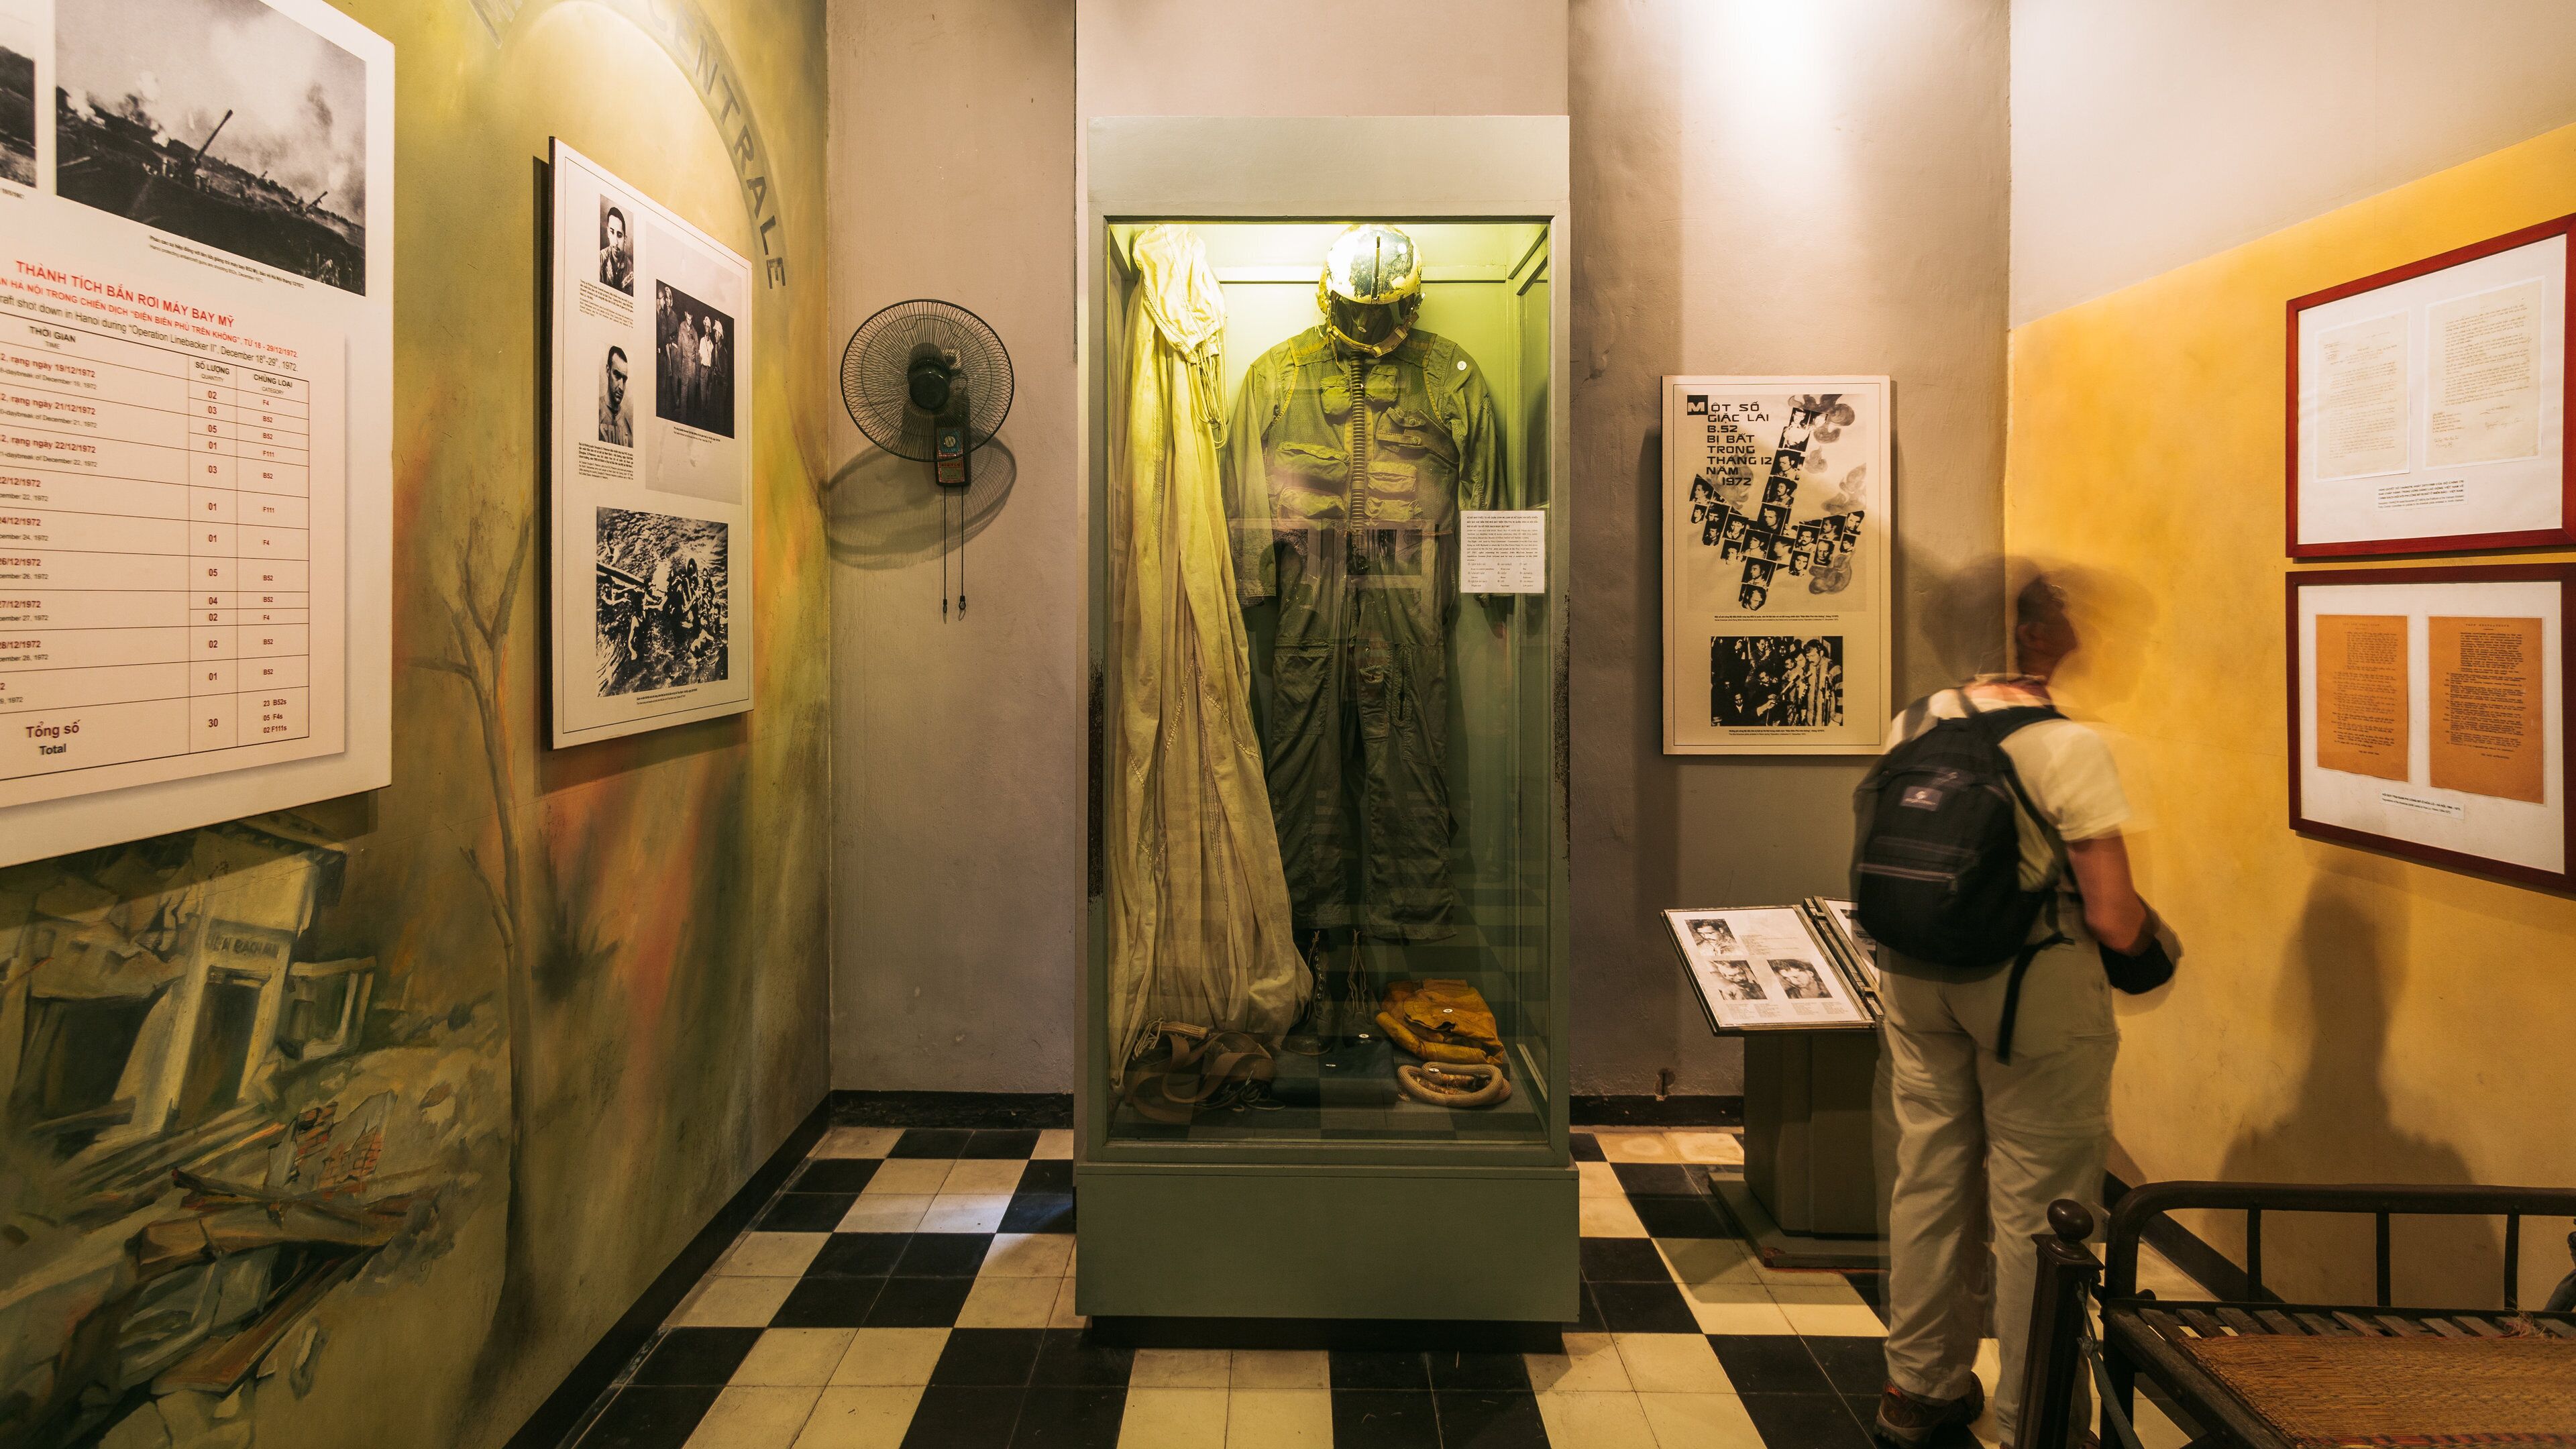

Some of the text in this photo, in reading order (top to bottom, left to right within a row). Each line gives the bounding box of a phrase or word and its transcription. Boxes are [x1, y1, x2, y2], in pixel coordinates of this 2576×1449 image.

[16, 260, 66, 284] THÀNH
[71, 276, 102, 294] TÍCH
[107, 284, 133, 302] BẮN
[138, 293, 159, 309] RƠI
[163, 301, 189, 315] MÁY
[192, 308, 215, 323] BAY
[219, 315, 235, 327] MỸ
[11, 279, 23, 289] HÀ
[27, 284, 44, 295] NỘI
[46, 288, 78, 303] TRONG
[80, 297, 105, 310] CHIẾN
[109, 305, 128, 316] DỊCH
[155, 316, 172, 327] BIÊN
[192, 325, 211, 337] TRÊN
[0, 295, 15, 305] raft
[17, 299, 37, 311] shot
[39, 304, 63, 316] down
[65, 311, 73, 319] in
[75, 311, 100, 325] Hanoi
[102, 318, 126, 333] during
[170, 333, 209, 351] Linebacker
[221, 346, 254, 362] December
[29, 326, 76, 343] THỜI GIAN
[45, 341, 60, 350] TIME
[32, 361, 53, 372] ngày
[55, 364, 96, 378] 19/12/1972
[195, 360, 205, 370] SỐ
[42, 375, 72, 385] December
[201, 373, 224, 382] QUANTITY
[208, 390, 218, 400] 02
[262, 386, 284, 395] CATEGORY
[33, 399, 53, 409] ngày
[55, 402, 96, 415] 21/12/1972
[208, 406, 218, 415] 03
[1687, 401, 1760, 413] MỘT SỐ
[42, 415, 72, 424] December
[1748, 412, 1769, 422] LÁI
[208, 425, 218, 433] 05
[1707, 425, 1737, 433] B.52
[1707, 433, 1755, 445] BỊ BẮT
[33, 439, 53, 449] ngày
[55, 441, 96, 453] 22/12/1972
[208, 441, 218, 450] 01
[1707, 445, 1755, 454] TRONG
[43, 455, 72, 464] December
[1707, 455, 1772, 465] THÁNG 12
[208, 465, 218, 474] 03
[1706, 465, 1739, 475] NĂM
[1722, 477, 1751, 486] 1972
[208, 502, 218, 511] 01
[208, 534, 218, 543] 01
[208, 596, 218, 605] 04
[208, 613, 218, 621] 02
[208, 640, 218, 648] 02
[208, 672, 218, 681] 01
[208, 718, 219, 728] 30
[25, 719, 81, 739] Tổng số
[39, 743, 66, 755] Total
